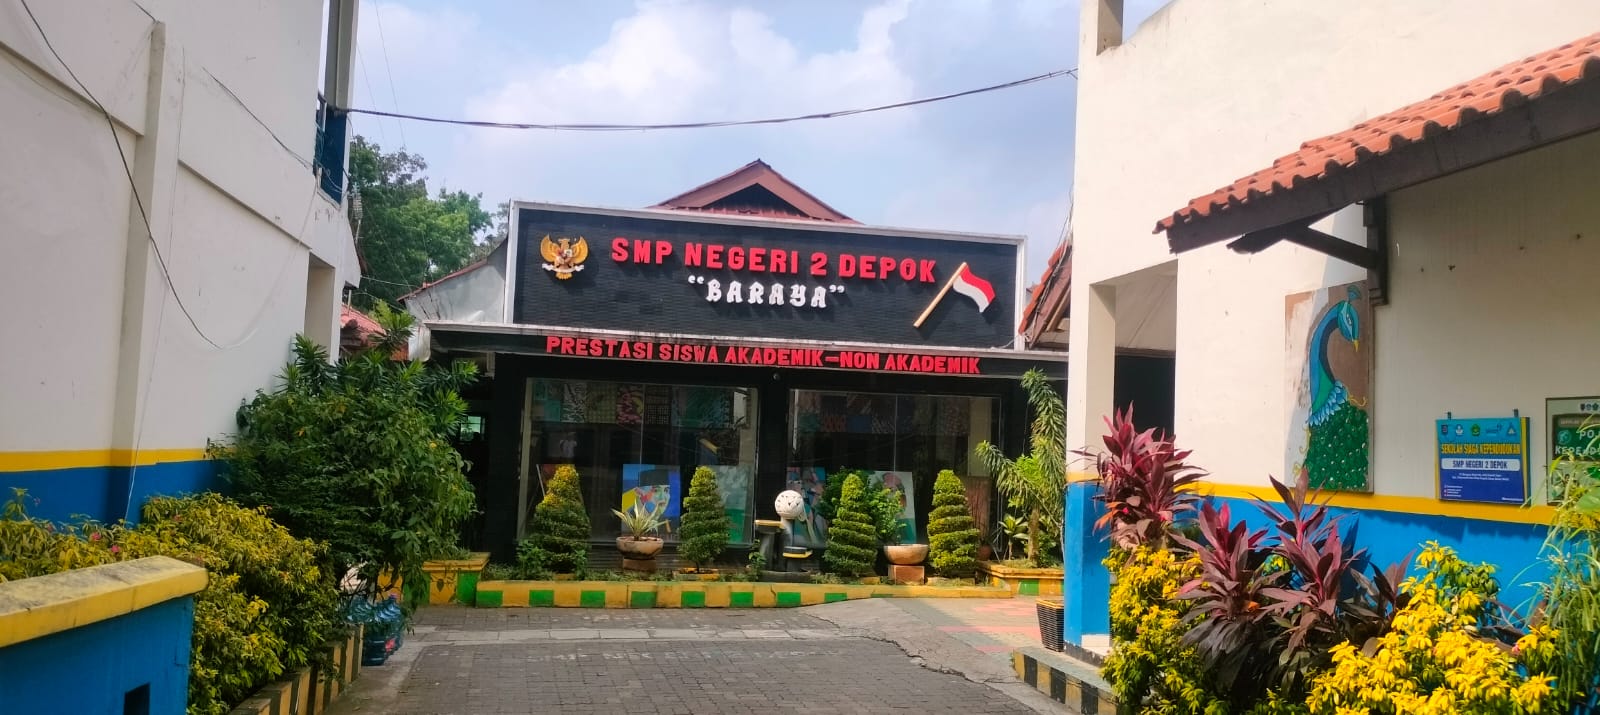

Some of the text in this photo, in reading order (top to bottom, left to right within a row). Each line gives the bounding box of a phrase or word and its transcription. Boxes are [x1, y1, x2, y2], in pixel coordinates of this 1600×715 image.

[611, 237, 937, 283] SMP NEGERI 2 DEPOK
[546, 335, 653, 360] PRESTASI
[659, 343, 719, 363] SISWA
[884, 353, 980, 375] AKADEMIK
[1452, 460, 1508, 469] SMP NEGERI 2 DEPOK
